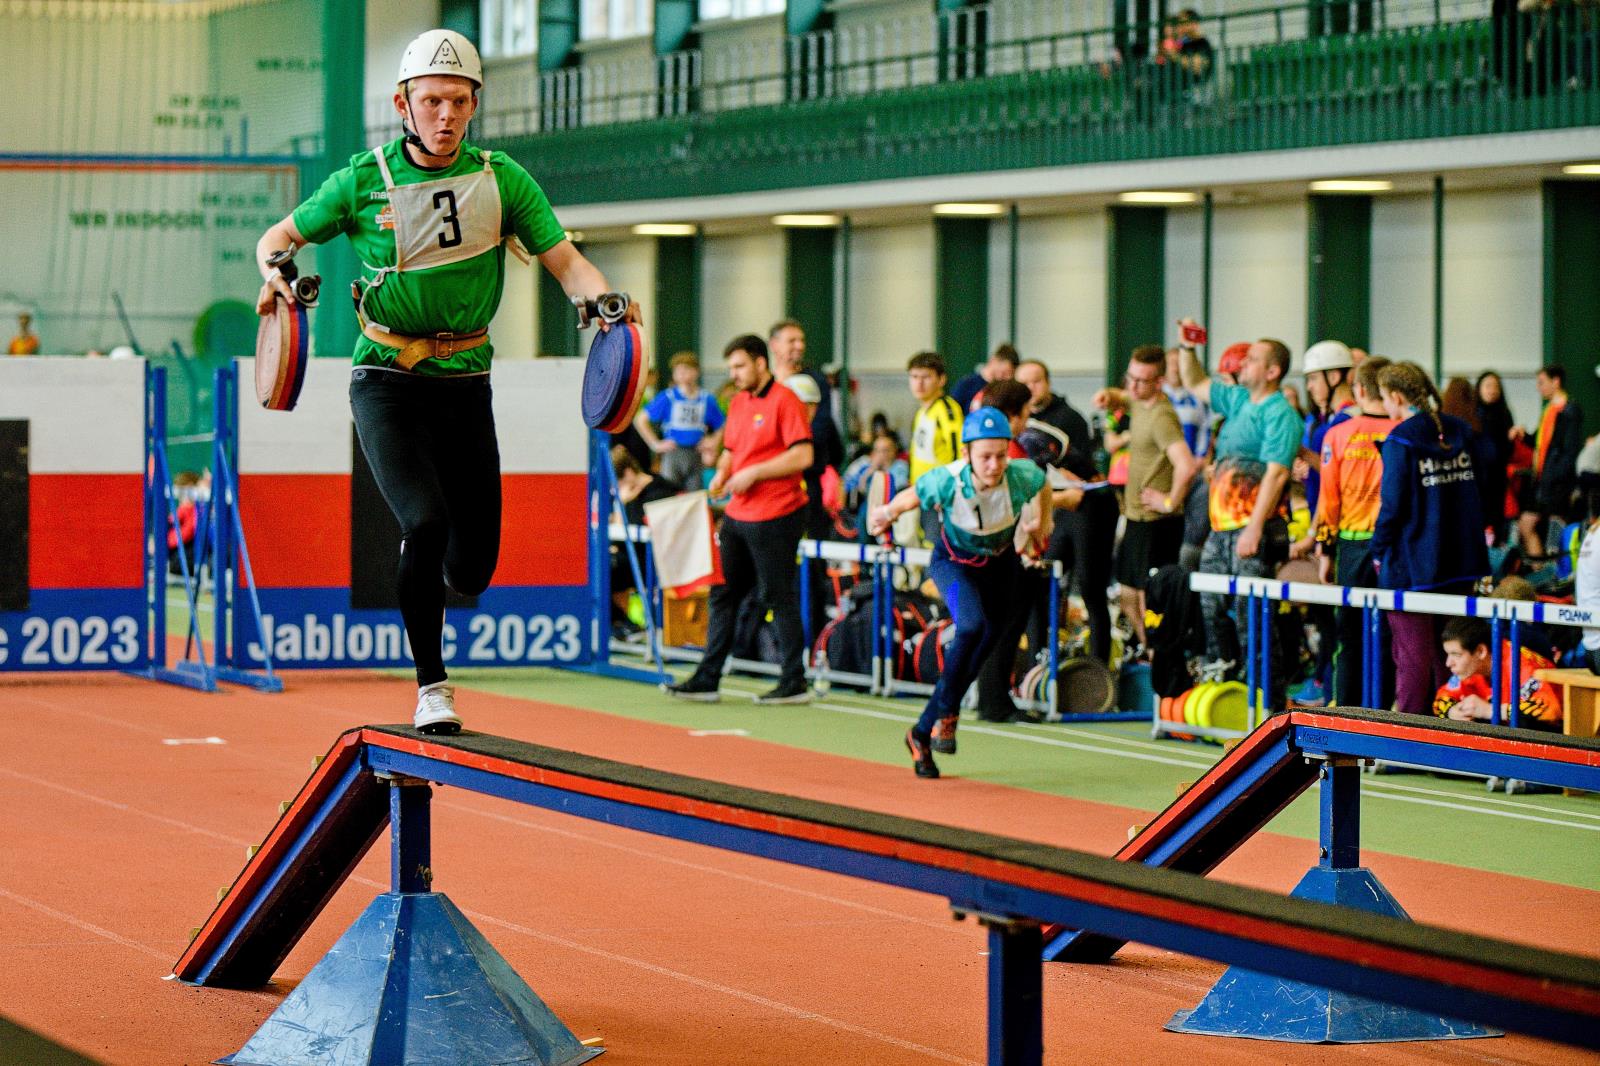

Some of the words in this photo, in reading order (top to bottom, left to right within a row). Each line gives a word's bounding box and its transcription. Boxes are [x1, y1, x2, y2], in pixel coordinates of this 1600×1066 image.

[432, 189, 463, 249] 3
[974, 504, 984, 530] 1
[21, 615, 140, 664] 2023
[468, 613, 582, 662] 2023
